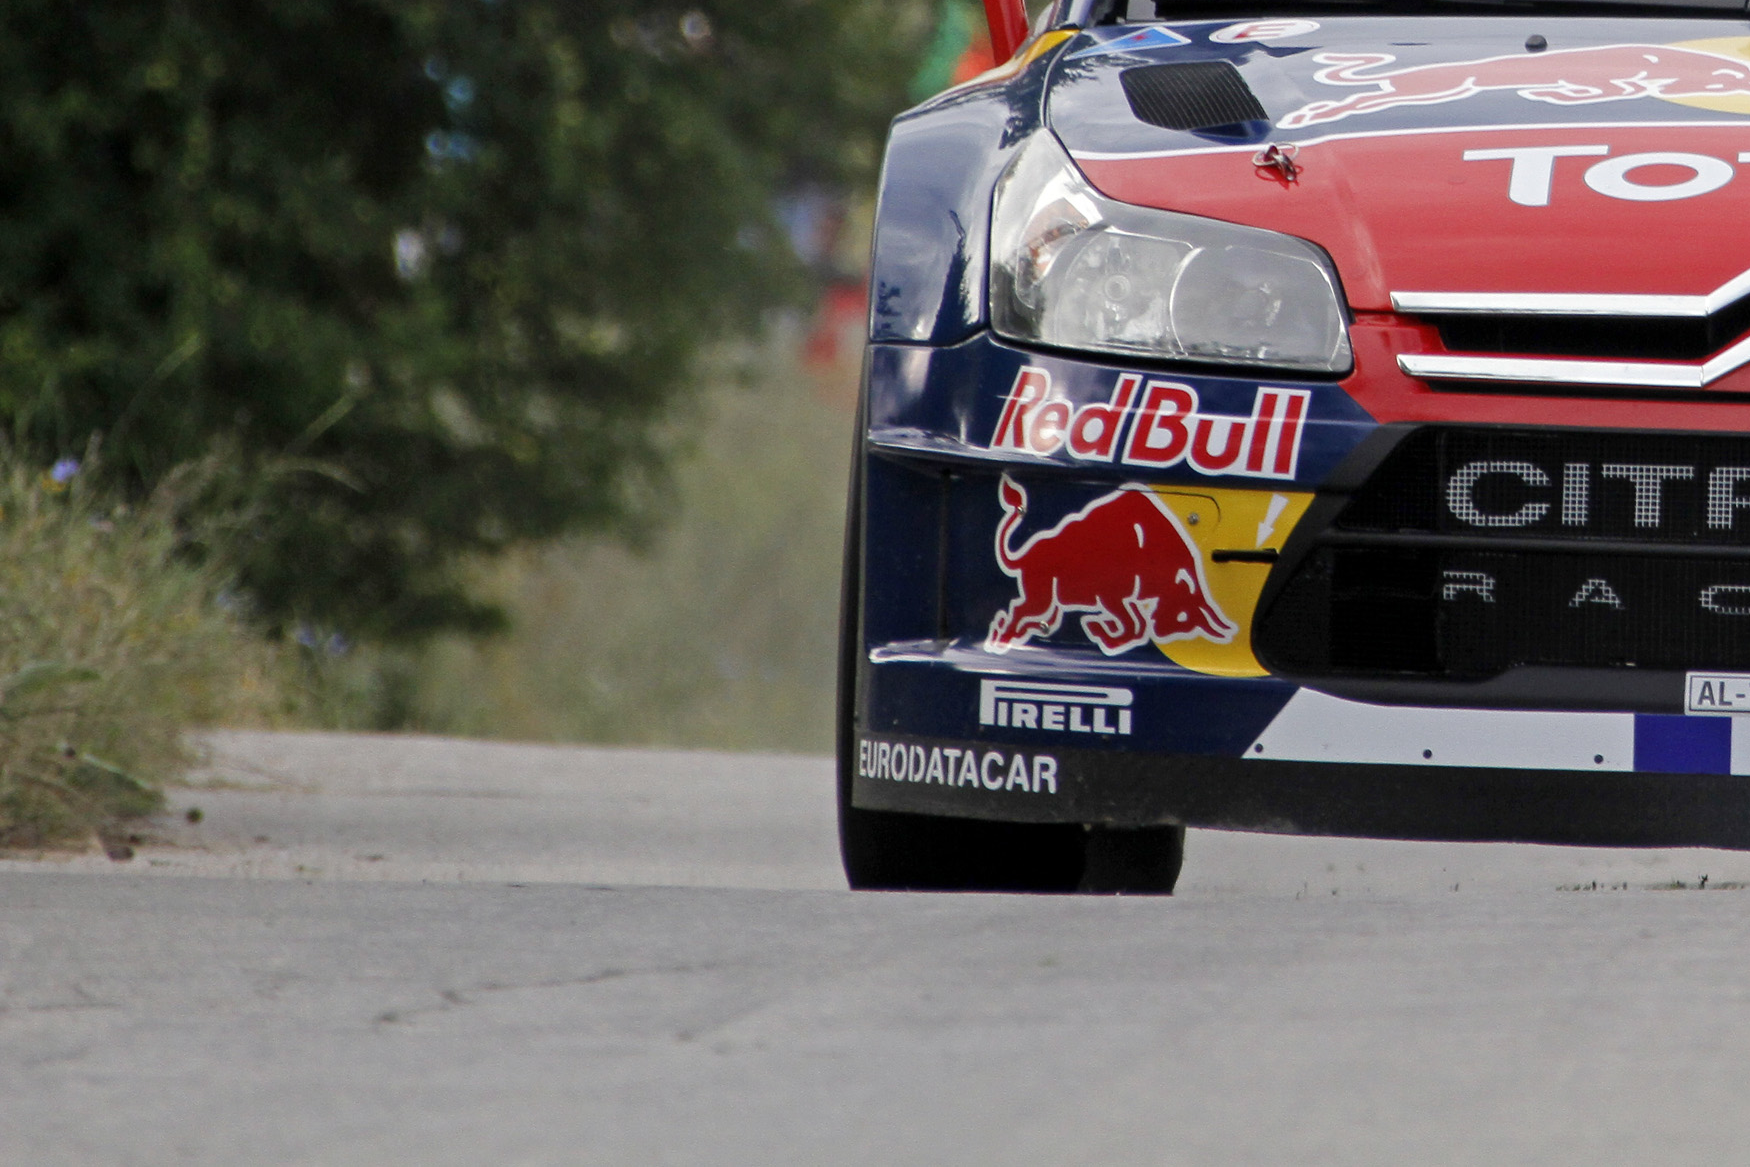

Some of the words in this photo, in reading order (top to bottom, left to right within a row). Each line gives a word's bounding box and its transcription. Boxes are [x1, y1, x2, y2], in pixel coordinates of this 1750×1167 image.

[991, 366, 1143, 463] Red
[1121, 381, 1312, 480] Bull
[980, 680, 1133, 734] PIRELLI
[858, 739, 1058, 794] EURODATACAR
